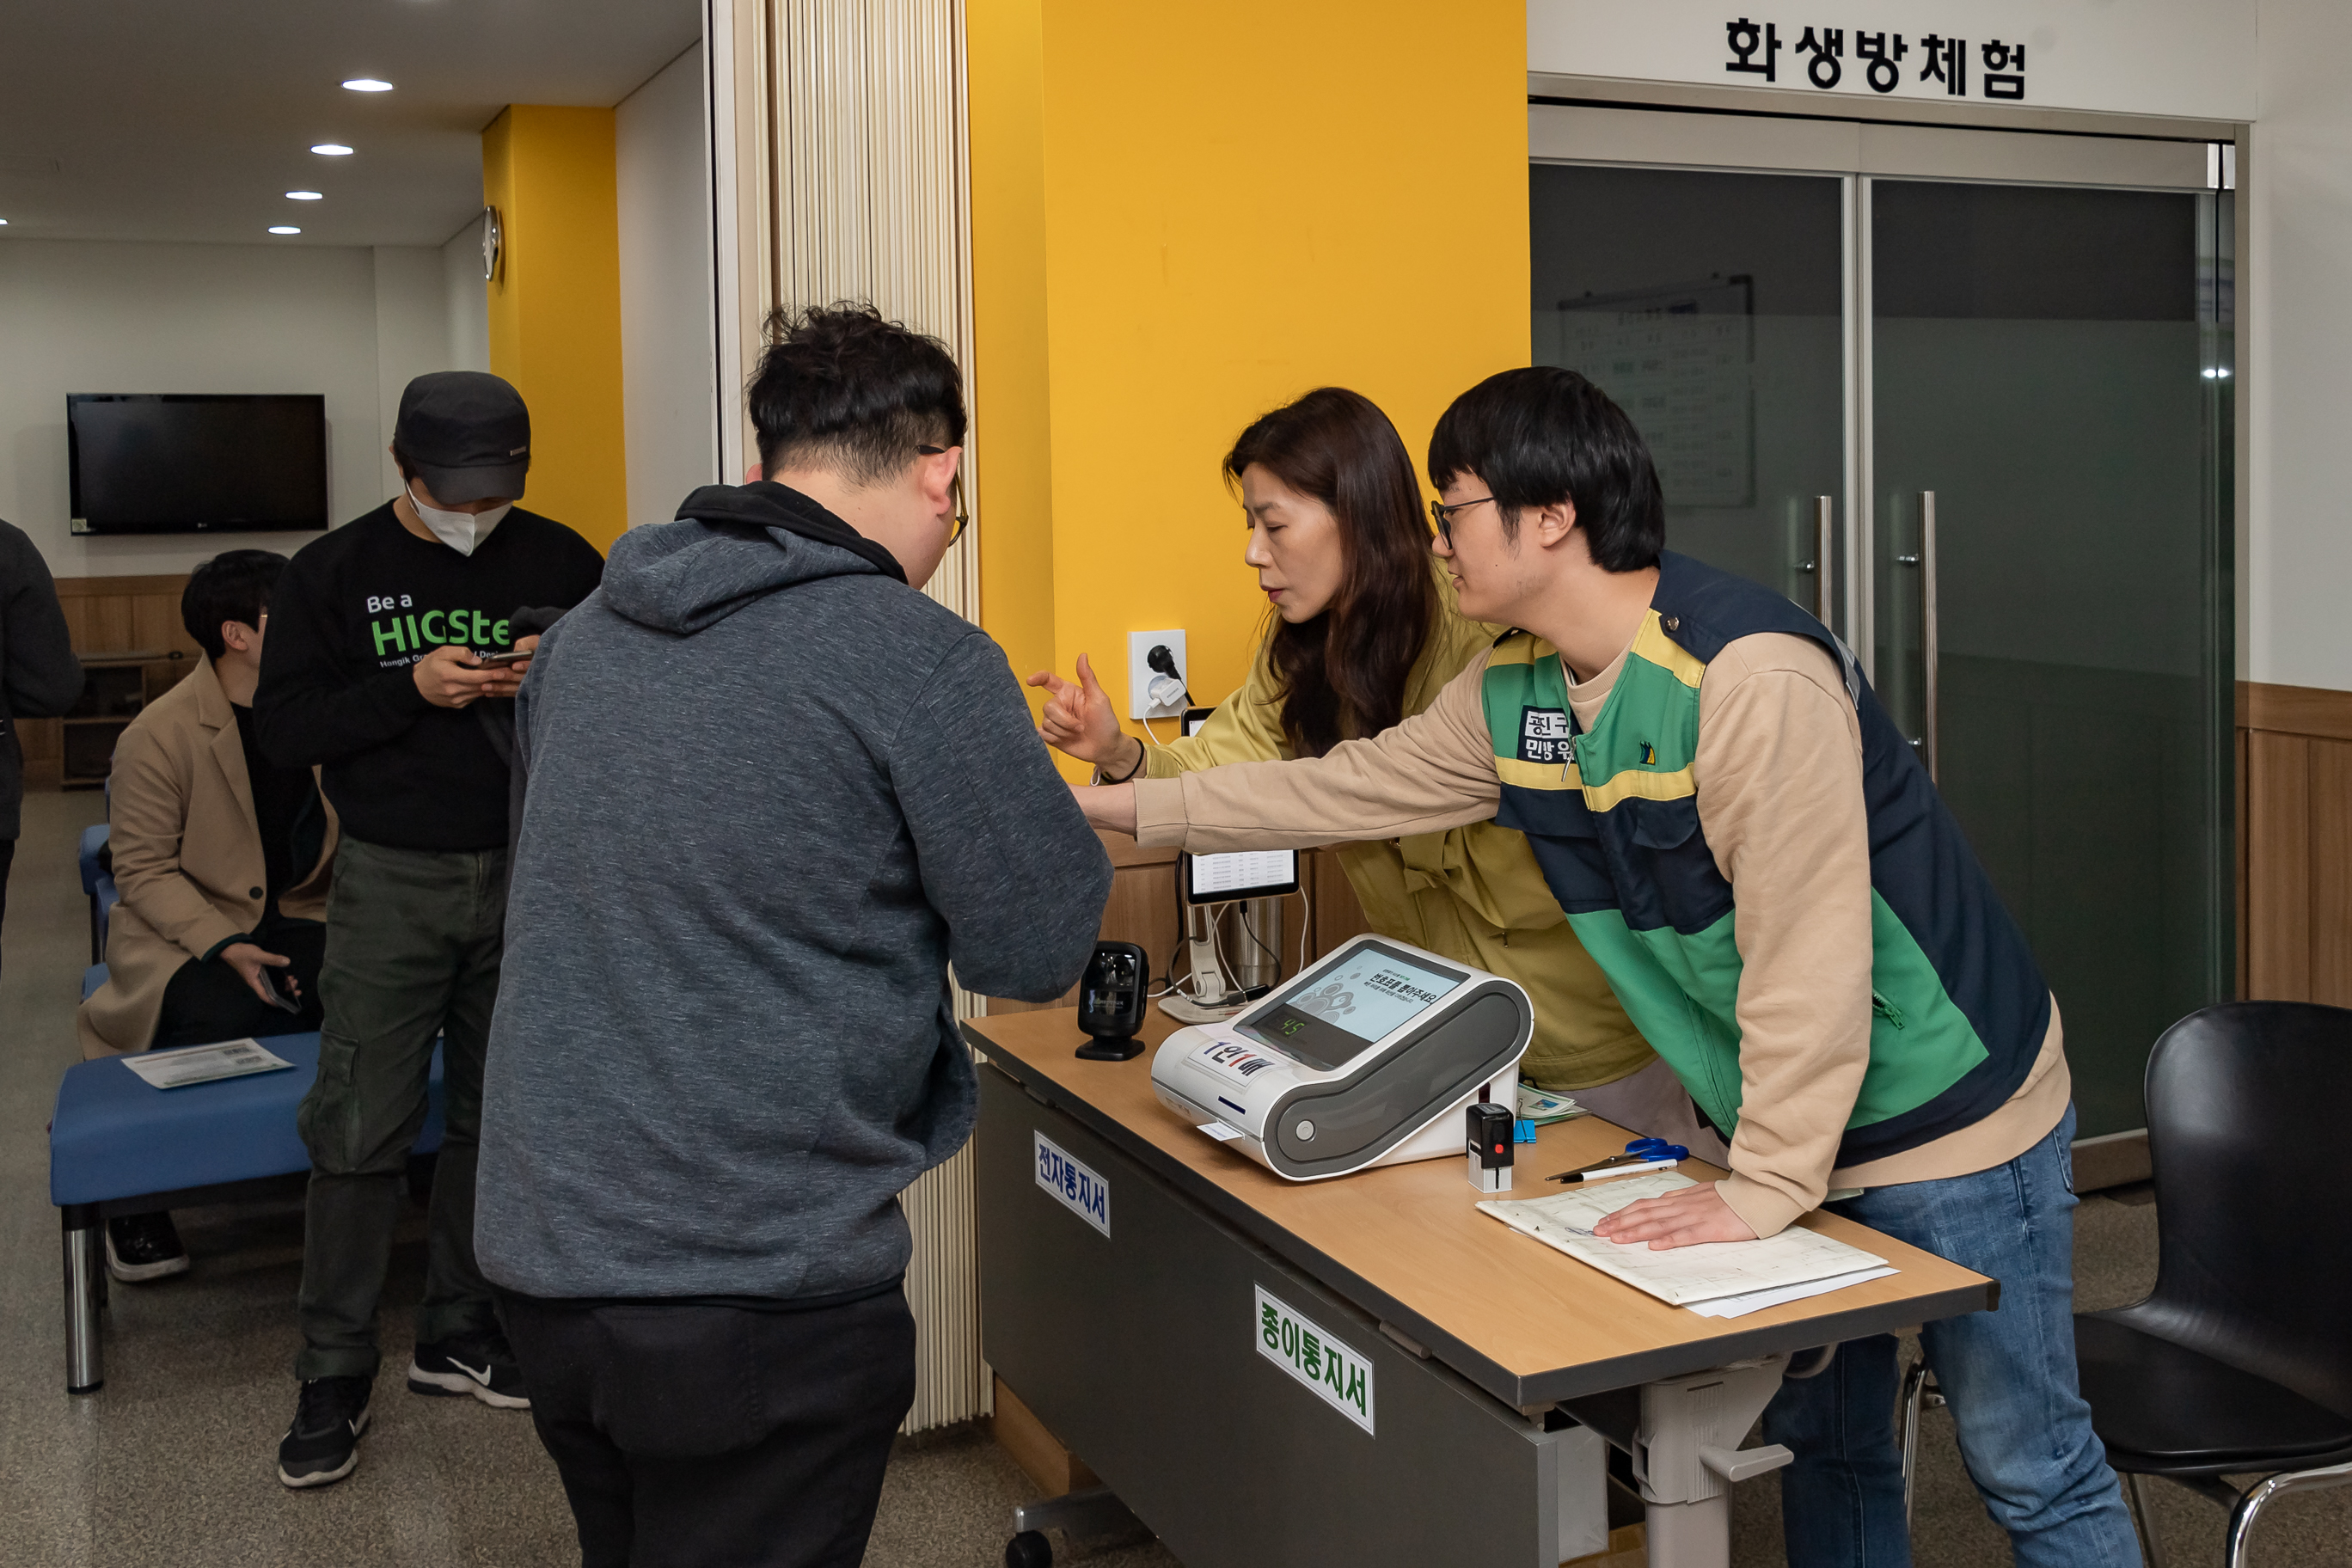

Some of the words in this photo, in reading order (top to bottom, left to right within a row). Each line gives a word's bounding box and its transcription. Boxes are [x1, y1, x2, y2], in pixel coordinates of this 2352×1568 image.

[1725, 17, 2025, 100] 화생방체험
[367, 595, 395, 614] Be
[400, 594, 413, 608] a
[380, 656, 411, 669] Hongik
[1369, 972, 1402, 990] 번호표를
[1282, 1019, 1305, 1035] 45
[1038, 1142, 1106, 1225] 전자통지서
[1261, 1301, 1367, 1418] 종이통지서
